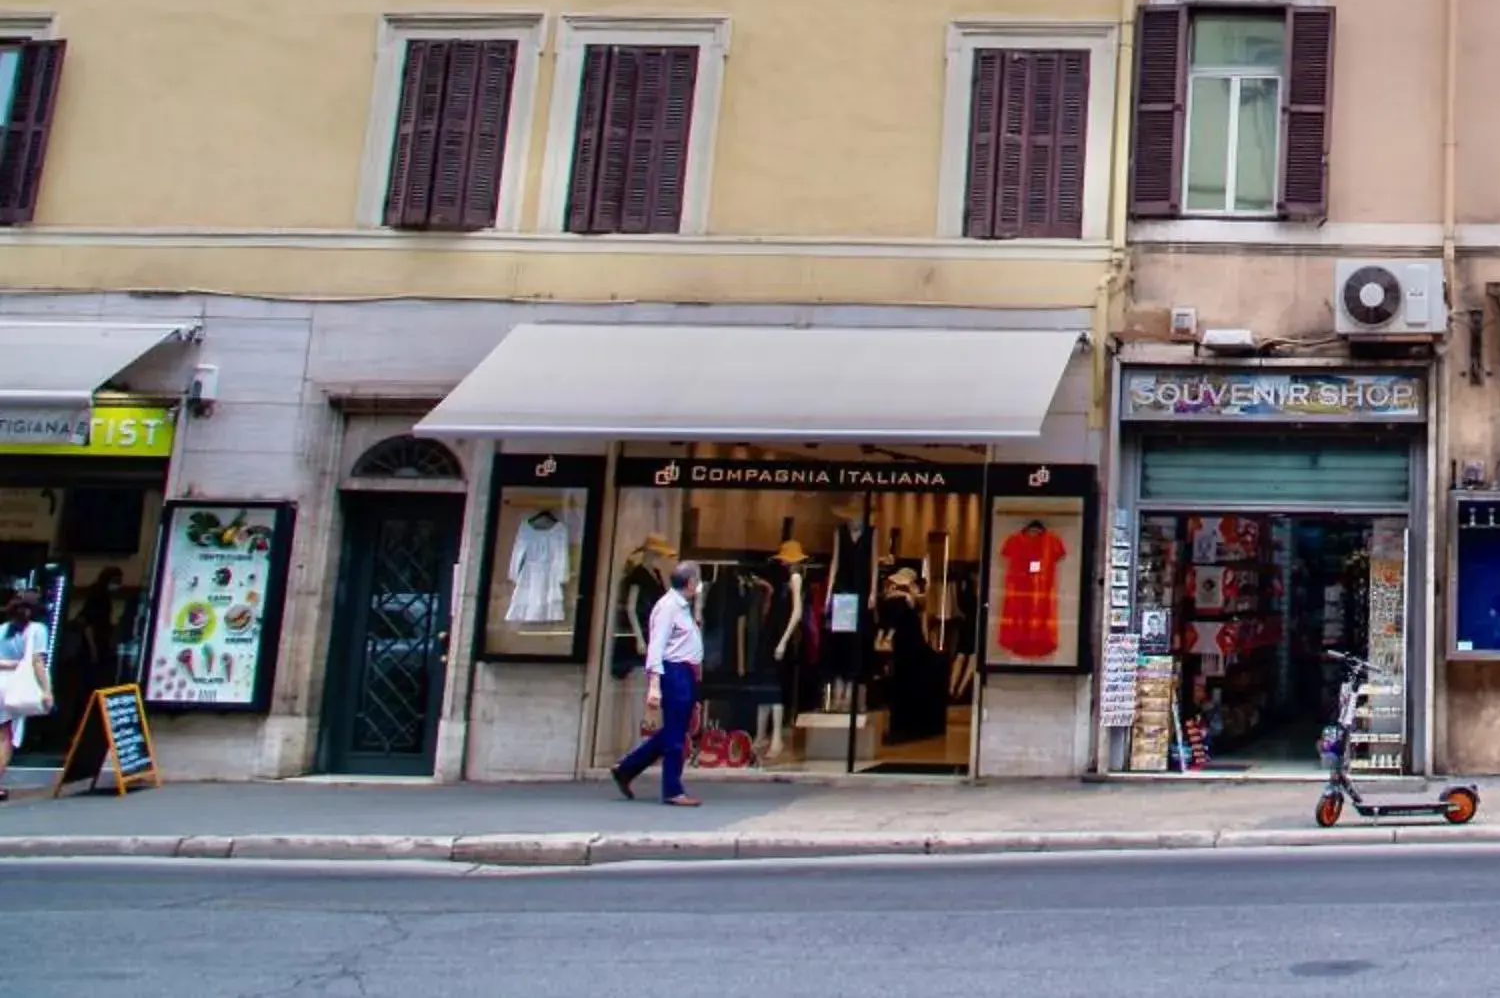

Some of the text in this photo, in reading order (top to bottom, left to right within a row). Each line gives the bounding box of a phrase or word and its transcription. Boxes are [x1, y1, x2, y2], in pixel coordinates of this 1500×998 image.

[1136, 382, 1414, 407] SOUVENIR SHOP
[691, 465, 946, 486] COMPAGNIA ITALIANA
